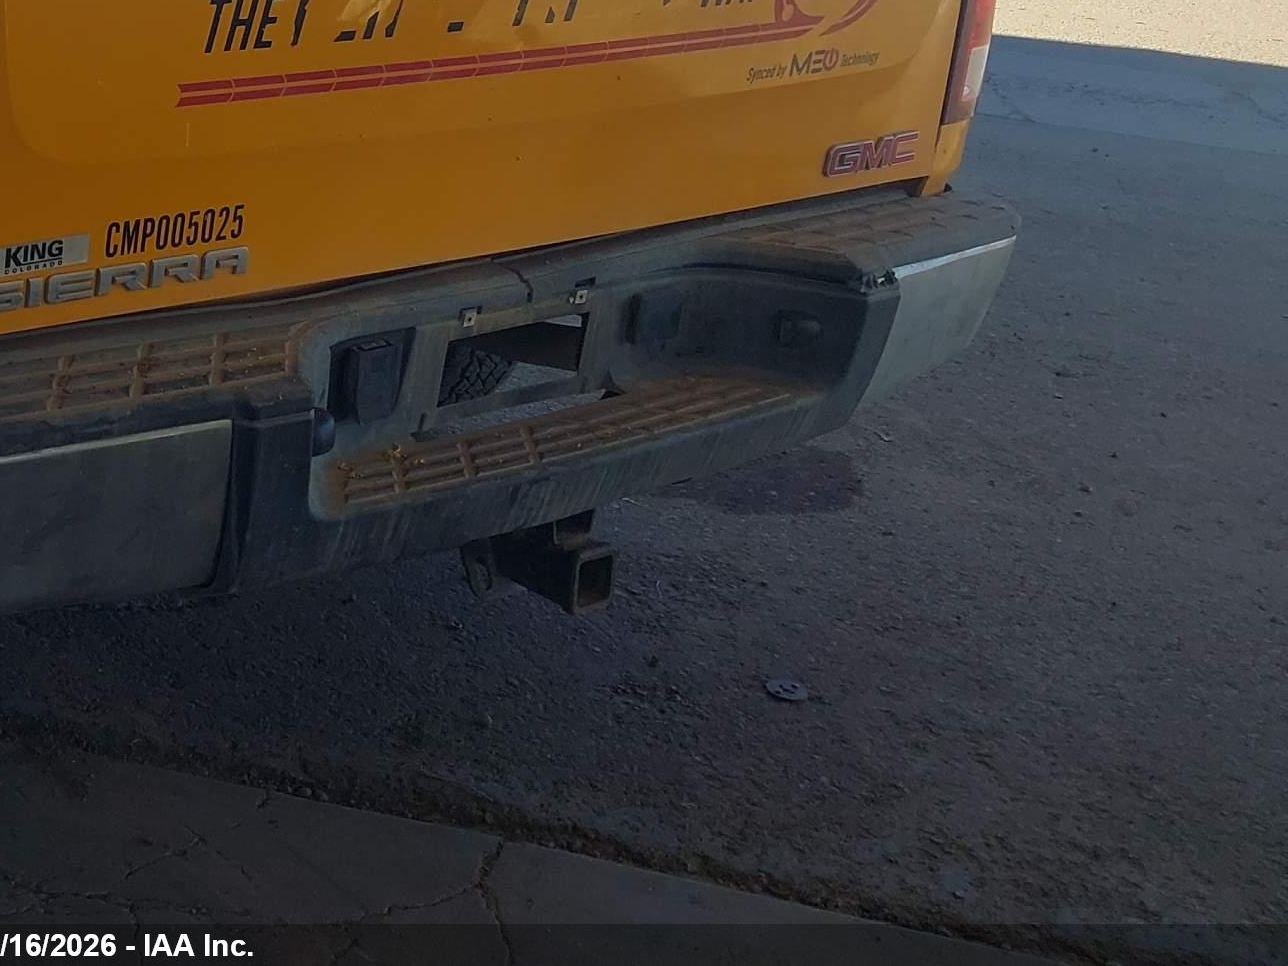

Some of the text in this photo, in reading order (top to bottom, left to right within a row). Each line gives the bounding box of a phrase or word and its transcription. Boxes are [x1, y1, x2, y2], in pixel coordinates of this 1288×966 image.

[746, 65, 776, 84] Synced
[776, 63, 788, 79] by
[822, 130, 920, 177] GMC
[105, 204, 245, 258] CMP005025
[4, 240, 63, 268] KING
[4, 260, 63, 275] COLORADO
